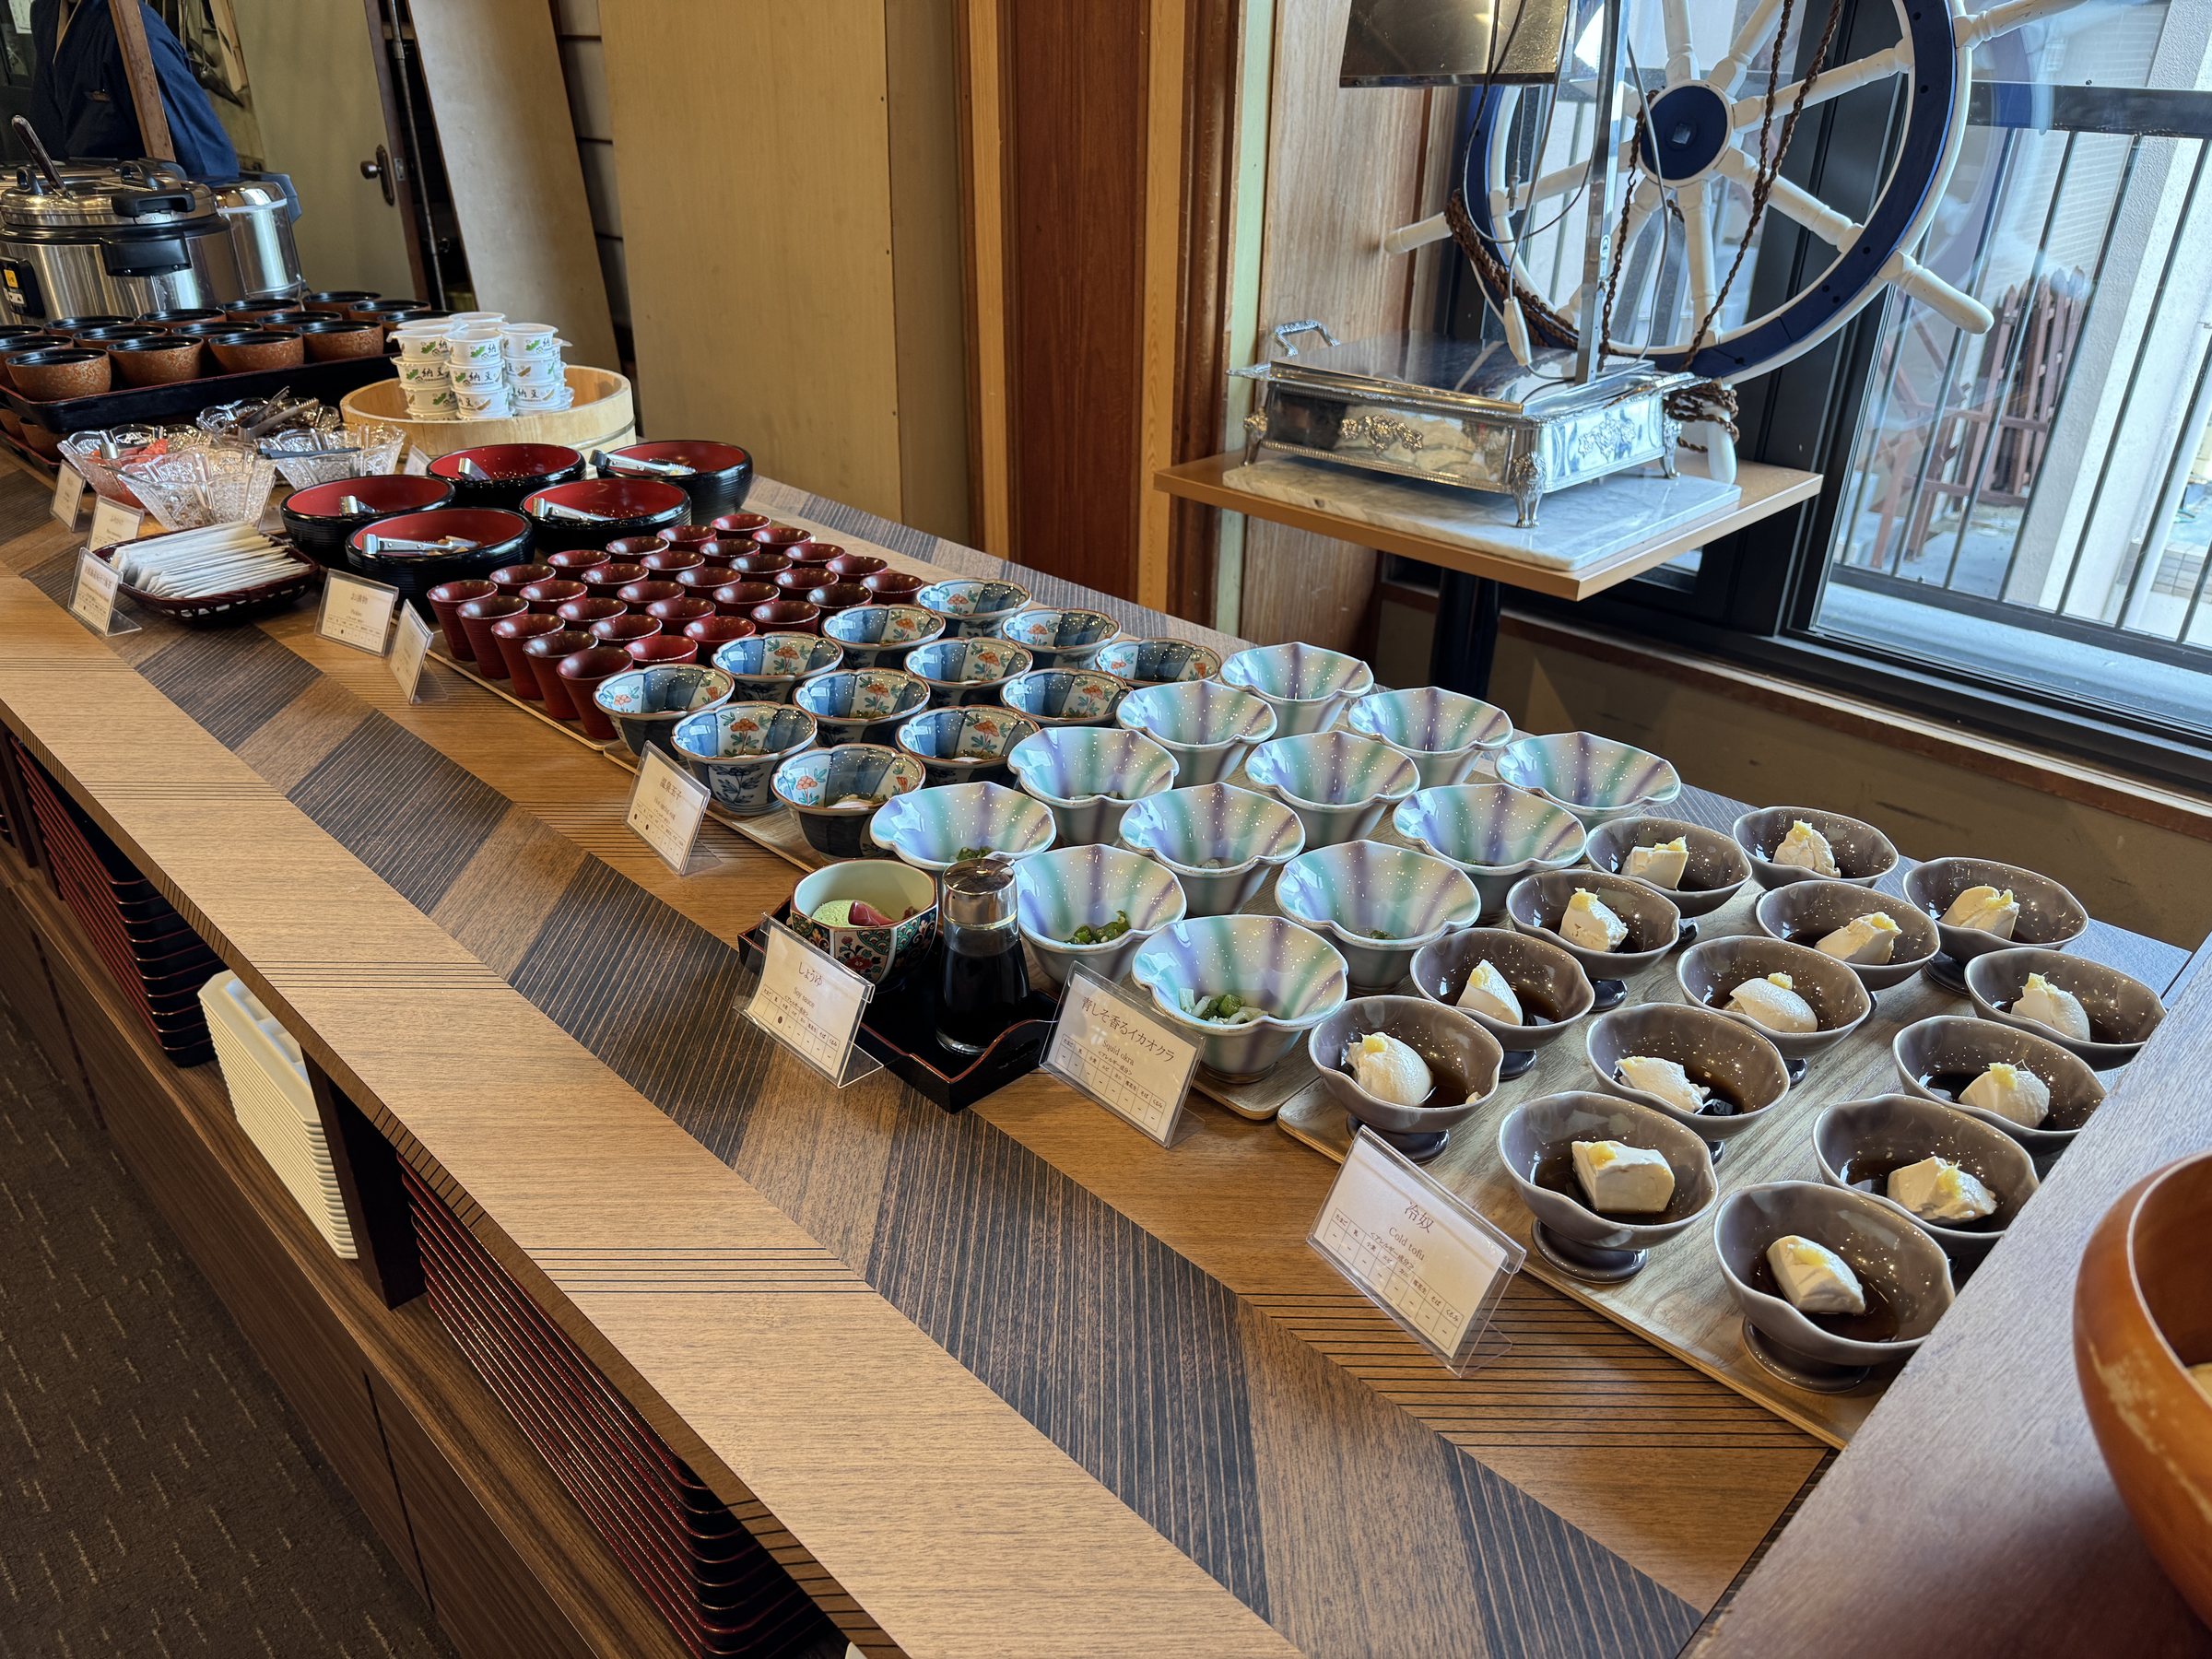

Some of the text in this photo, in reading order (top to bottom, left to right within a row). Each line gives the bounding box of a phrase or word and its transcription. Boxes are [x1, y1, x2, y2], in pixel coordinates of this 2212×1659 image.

[469, 371, 492, 382] 納豆
[659, 777, 682, 800] 温泉玉子
[799, 961, 823, 986] しょうゆ
[793, 987, 815, 1008] Soy sauce
[1081, 996, 1175, 1063] 青しそ香るイカオクラ
[1102, 1040, 1135, 1065] Squid okra
[1404, 1201, 1434, 1233] 冷奴
[1388, 1227, 1425, 1261] Cold tofu
